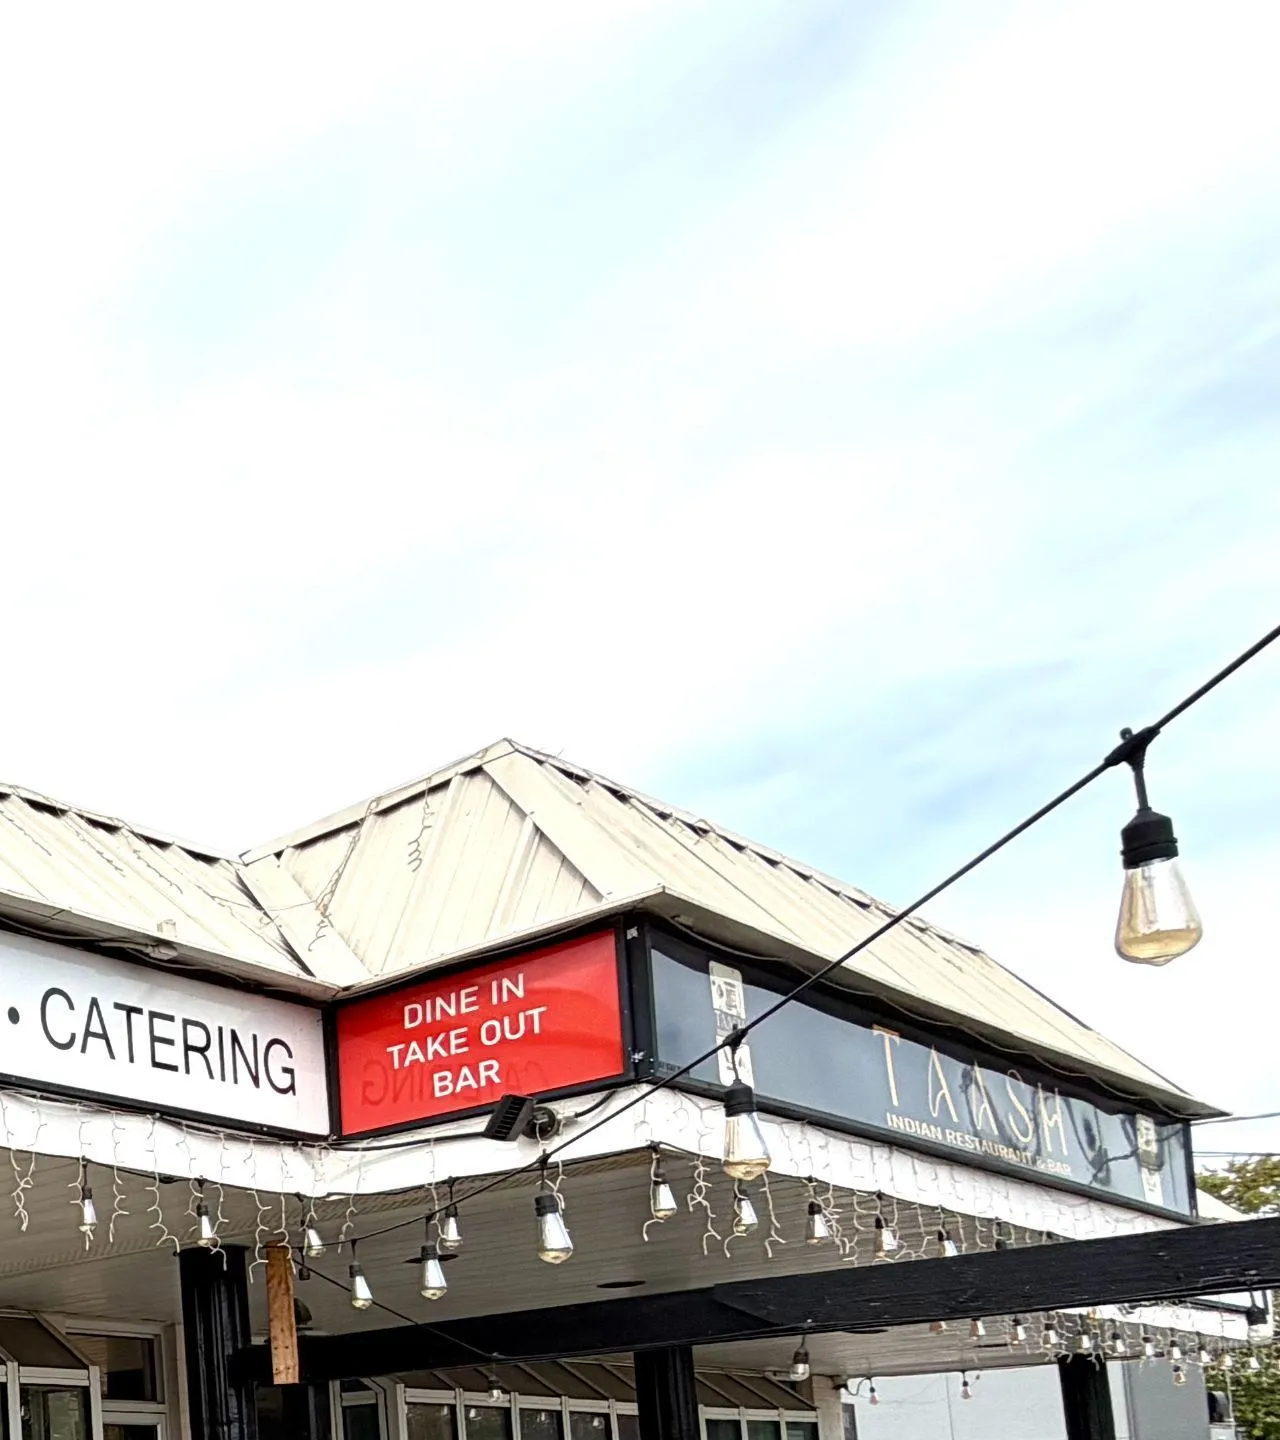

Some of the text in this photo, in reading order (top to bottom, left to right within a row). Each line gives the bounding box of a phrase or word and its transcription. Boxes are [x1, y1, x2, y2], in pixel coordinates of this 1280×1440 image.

[403, 972, 526, 1030] DINE IN
[40, 986, 298, 1098] CATERING
[385, 1005, 549, 1071] TAKE OUT
[432, 1058, 503, 1099] BAR
[871, 1023, 1069, 1157] TAASH
[885, 1111, 943, 1141] INDIAN
[945, 1128, 1034, 1166] RESTAURANT
